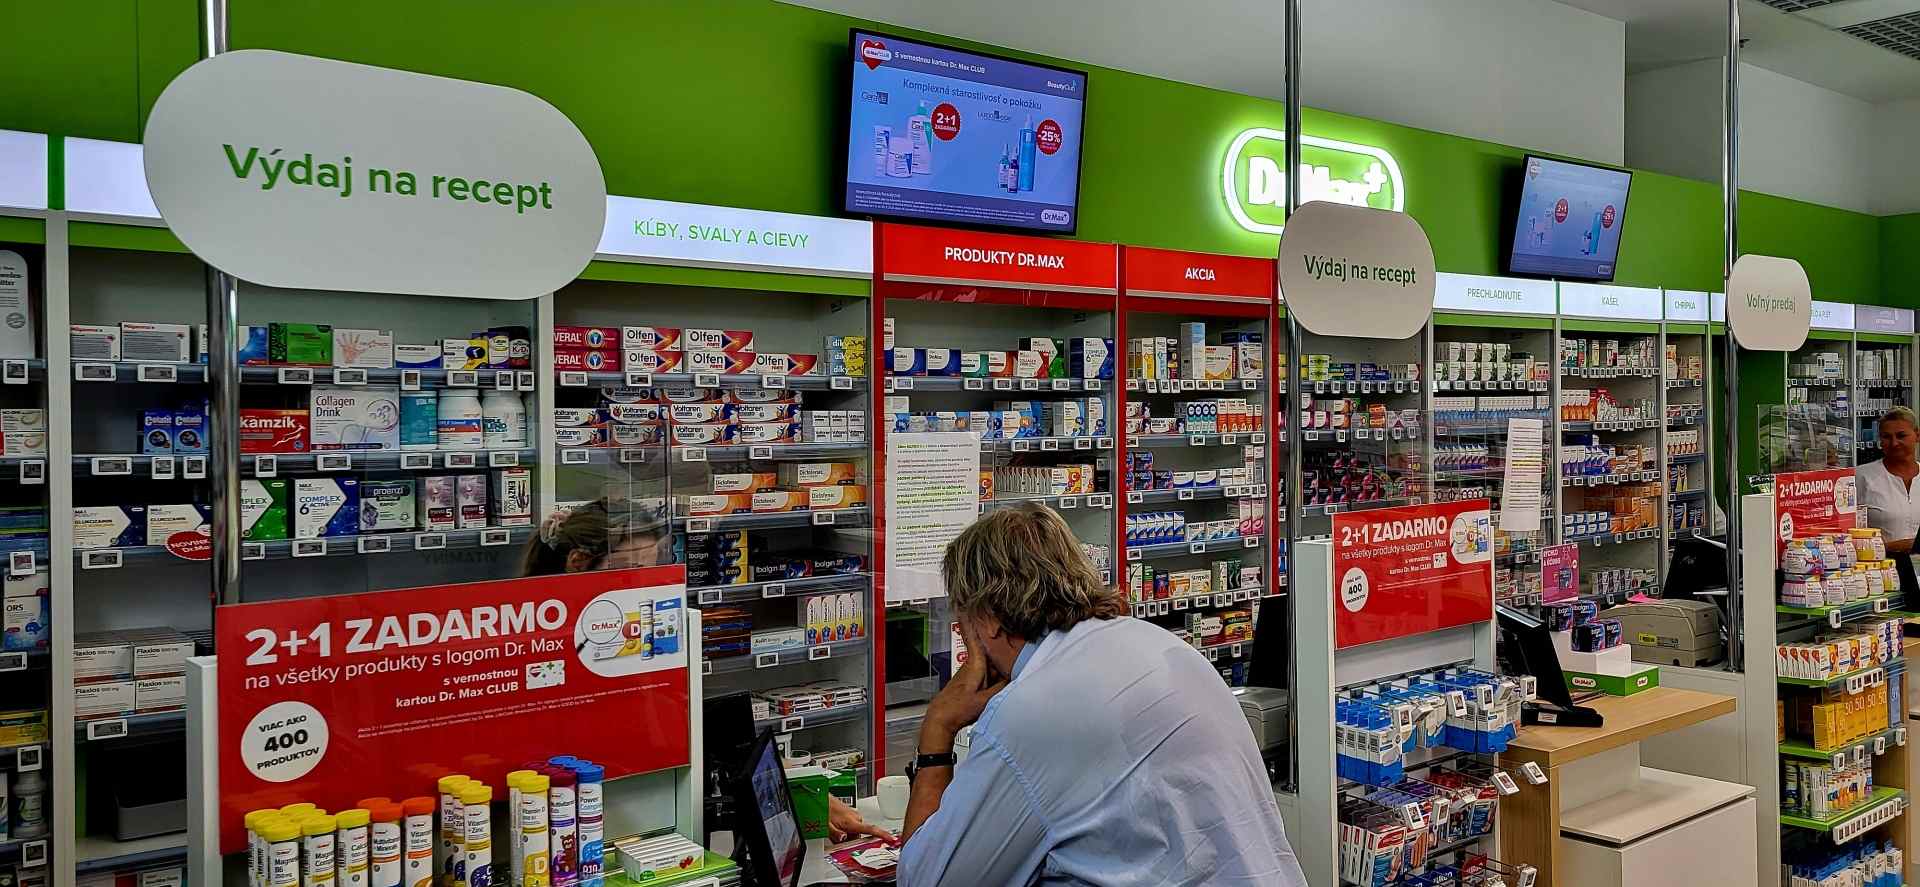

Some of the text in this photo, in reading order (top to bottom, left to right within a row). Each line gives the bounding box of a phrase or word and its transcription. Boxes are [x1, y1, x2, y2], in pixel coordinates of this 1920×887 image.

[970, 65, 985, 74] CLUB
[903, 79, 951, 95] Komplexná
[936, 112, 956, 126] 2+1
[1038, 131, 1061, 143] -25%
[222, 144, 553, 214] Výdaj na recept
[688, 225, 742, 243] SVALY
[747, 231, 758, 244] A
[763, 231, 809, 248] CIEVY
[945, 247, 1065, 268] PRODUKTY DR.MAX
[1184, 267, 1216, 281] AKCIA
[1303, 254, 1417, 287] Výdaj na recept
[1467, 288, 1522, 301] PRECHLADNUTIE
[1772, 295, 1796, 315] predaj
[626, 329, 653, 340] Olfen
[690, 330, 720, 342] Olfen
[630, 352, 656, 363] Olfen
[693, 352, 724, 364] Olfen
[756, 355, 784, 366] Olfen
[315, 396, 355, 408] Collagen
[315, 406, 341, 417] Drink
[1780, 479, 1834, 498] 2+1 ZADARMO
[300, 495, 341, 503] COMPLEX
[299, 503, 310, 515] 6
[1341, 516, 1448, 547] 2+1 ZADARMO
[170, 538, 209, 549] NOVINK
[1351, 547, 1372, 559] všetky
[1372, 545, 1400, 558] produkty
[1434, 539, 1447, 547] Max
[688, 552, 709, 560] Ibalgin
[755, 565, 778, 574] Ibalgin
[814, 560, 837, 568] Ibalgin
[688, 570, 709, 578] Ibalgin
[1348, 583, 1363, 594] 400
[6, 603, 24, 612] ORS
[245, 598, 568, 666] 2+1 ZADARMO
[245, 637, 565, 690] na všetky produkty s logom Dr. Max
[443, 667, 519, 685] s vernostnou
[395, 681, 519, 708] kartou Dr. Max CLUB
[258, 715, 307, 733] VIAC AKO
[264, 729, 309, 752] 400
[257, 746, 320, 770] PRODUKTOV
